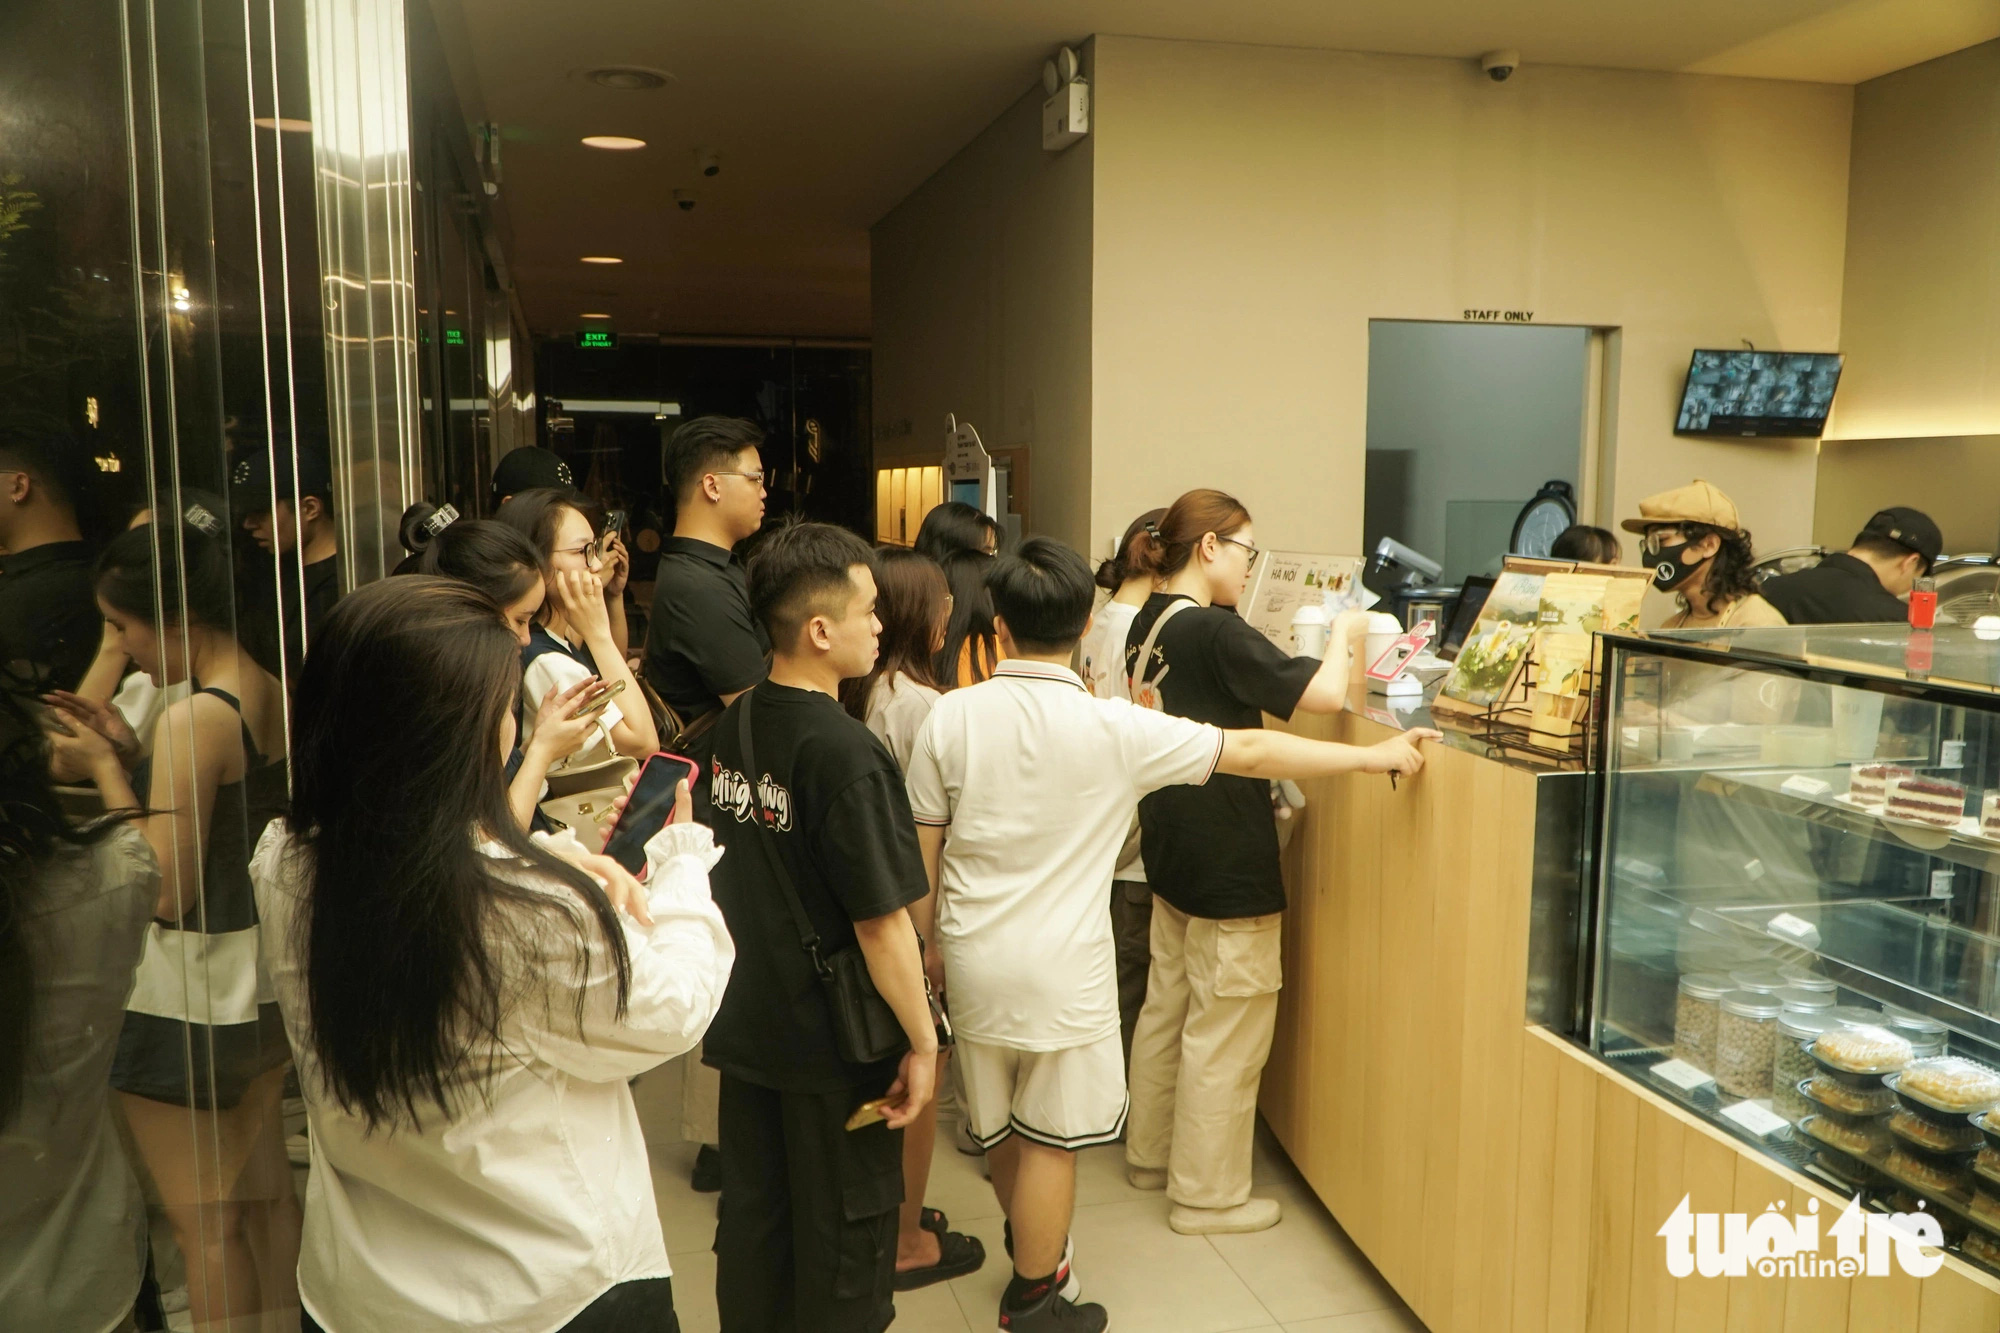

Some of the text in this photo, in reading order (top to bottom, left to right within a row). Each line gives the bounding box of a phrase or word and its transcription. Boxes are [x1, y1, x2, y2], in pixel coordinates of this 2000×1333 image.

[1463, 309, 1534, 322] STAFF ONLY
[585, 333, 608, 341] EXIT
[711, 772, 788, 825] Mixiging
